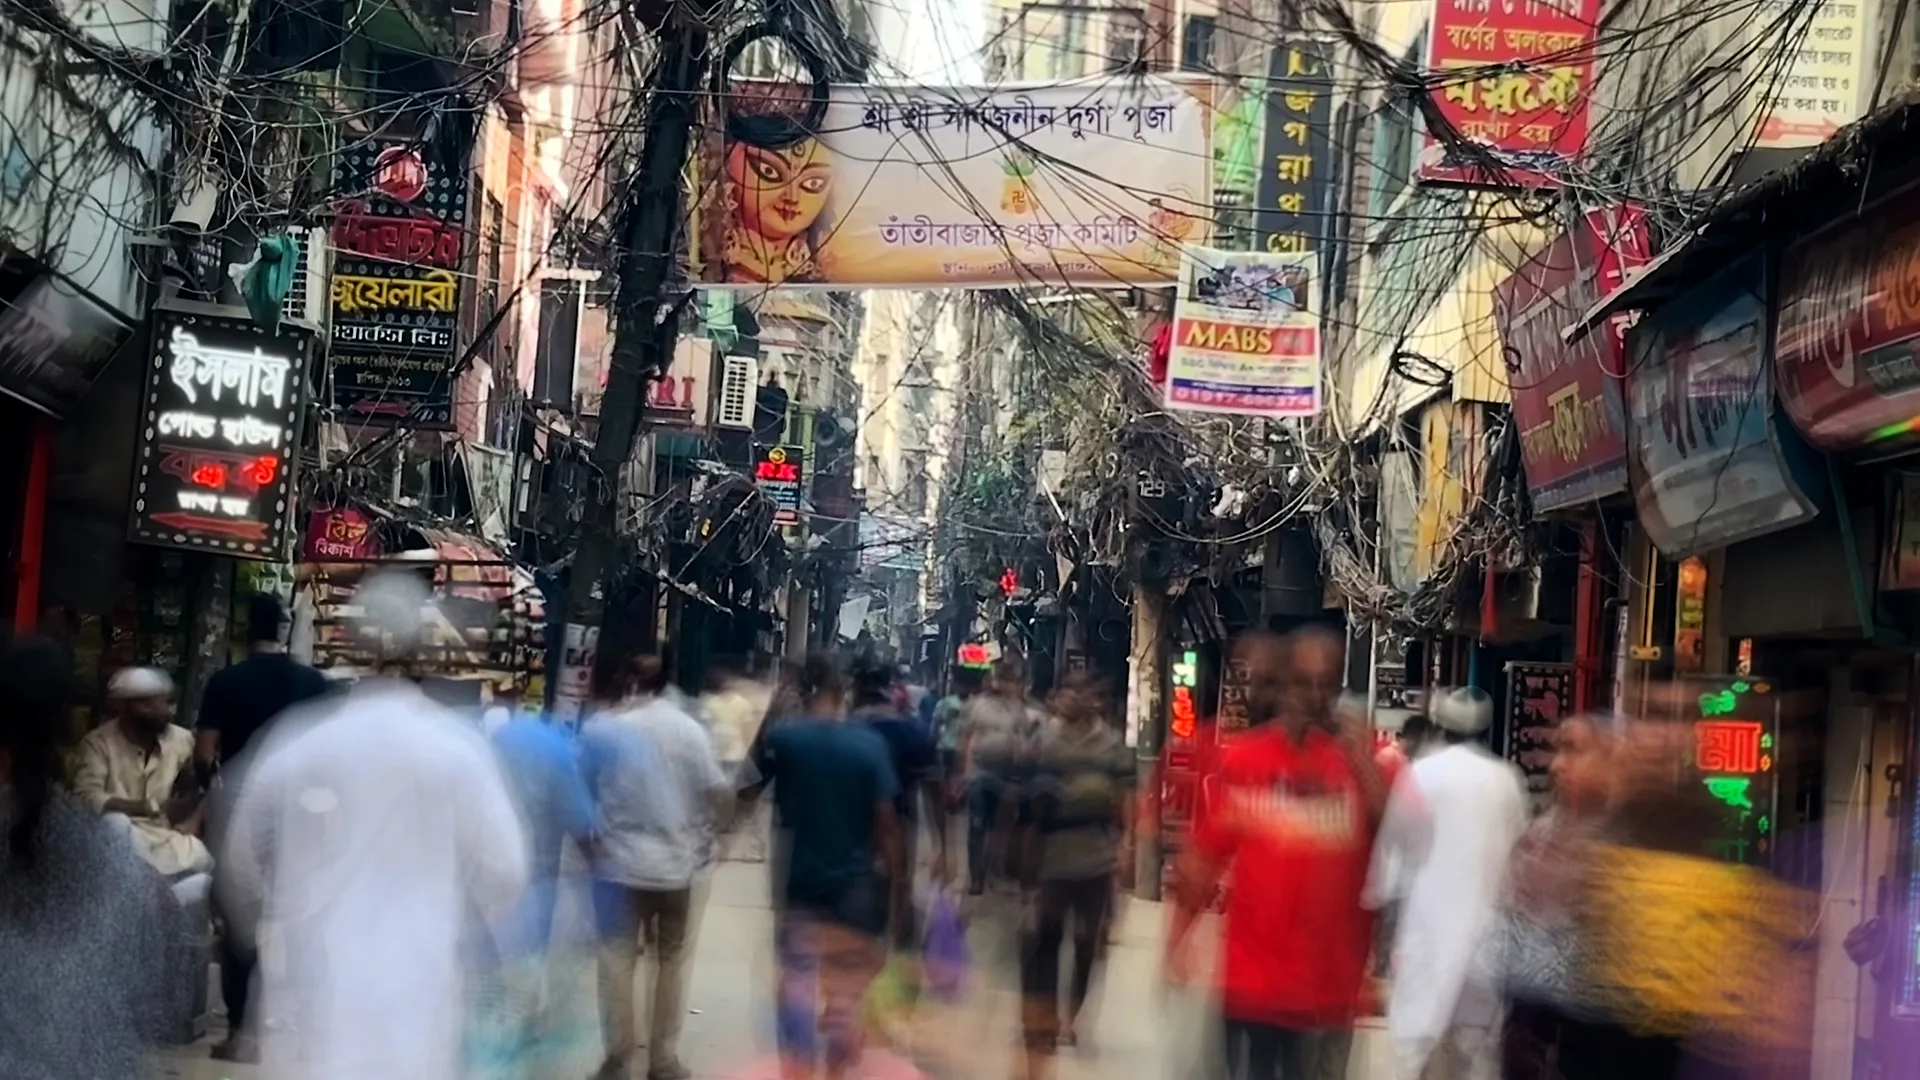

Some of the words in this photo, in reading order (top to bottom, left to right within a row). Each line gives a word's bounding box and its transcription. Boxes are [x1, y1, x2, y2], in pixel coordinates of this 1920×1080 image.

[1445, 18, 1498, 51] স্বর্ণের
[1123, 104, 1176, 143] পূজা
[1518, 123, 1557, 143] হয়
[878, 214, 1005, 247] তাঁতীবাজার
[1015, 222, 1061, 254] পূজা
[1072, 215, 1140, 245] কমিটি
[1184, 321, 1275, 354] MABS
[169, 325, 291, 410] ইসলাম
